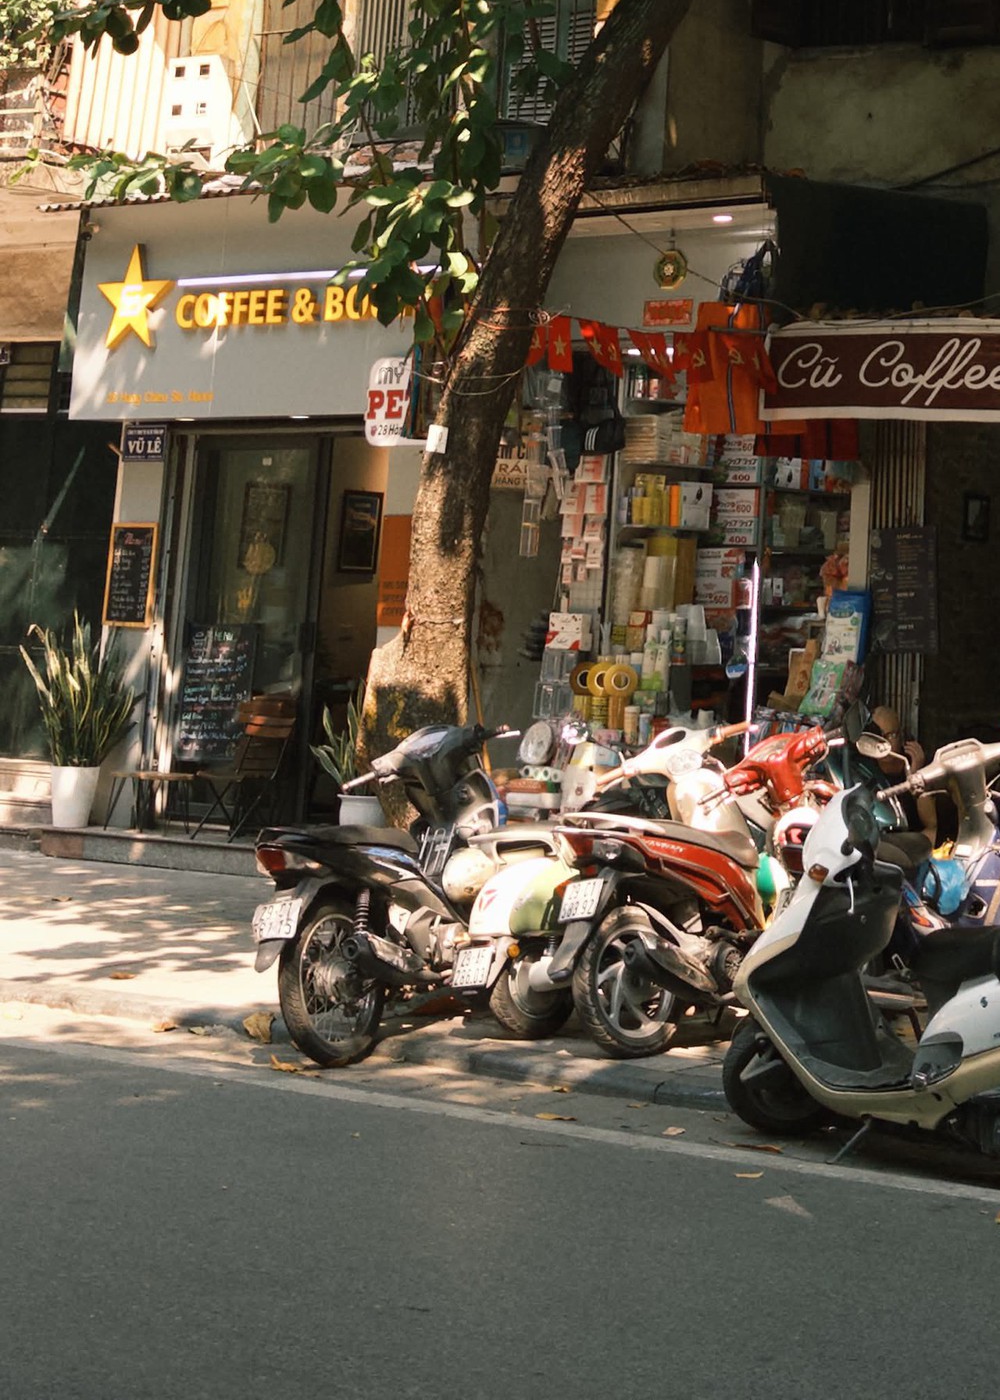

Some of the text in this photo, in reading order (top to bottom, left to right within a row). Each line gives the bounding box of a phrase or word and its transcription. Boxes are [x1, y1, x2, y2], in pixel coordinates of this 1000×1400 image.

[175, 289, 286, 329] COFFEE
[291, 287, 316, 323] &
[777, 342, 843, 389] Cũ
[731, 474, 751, 482] 400
[729, 536, 747, 544] 400
